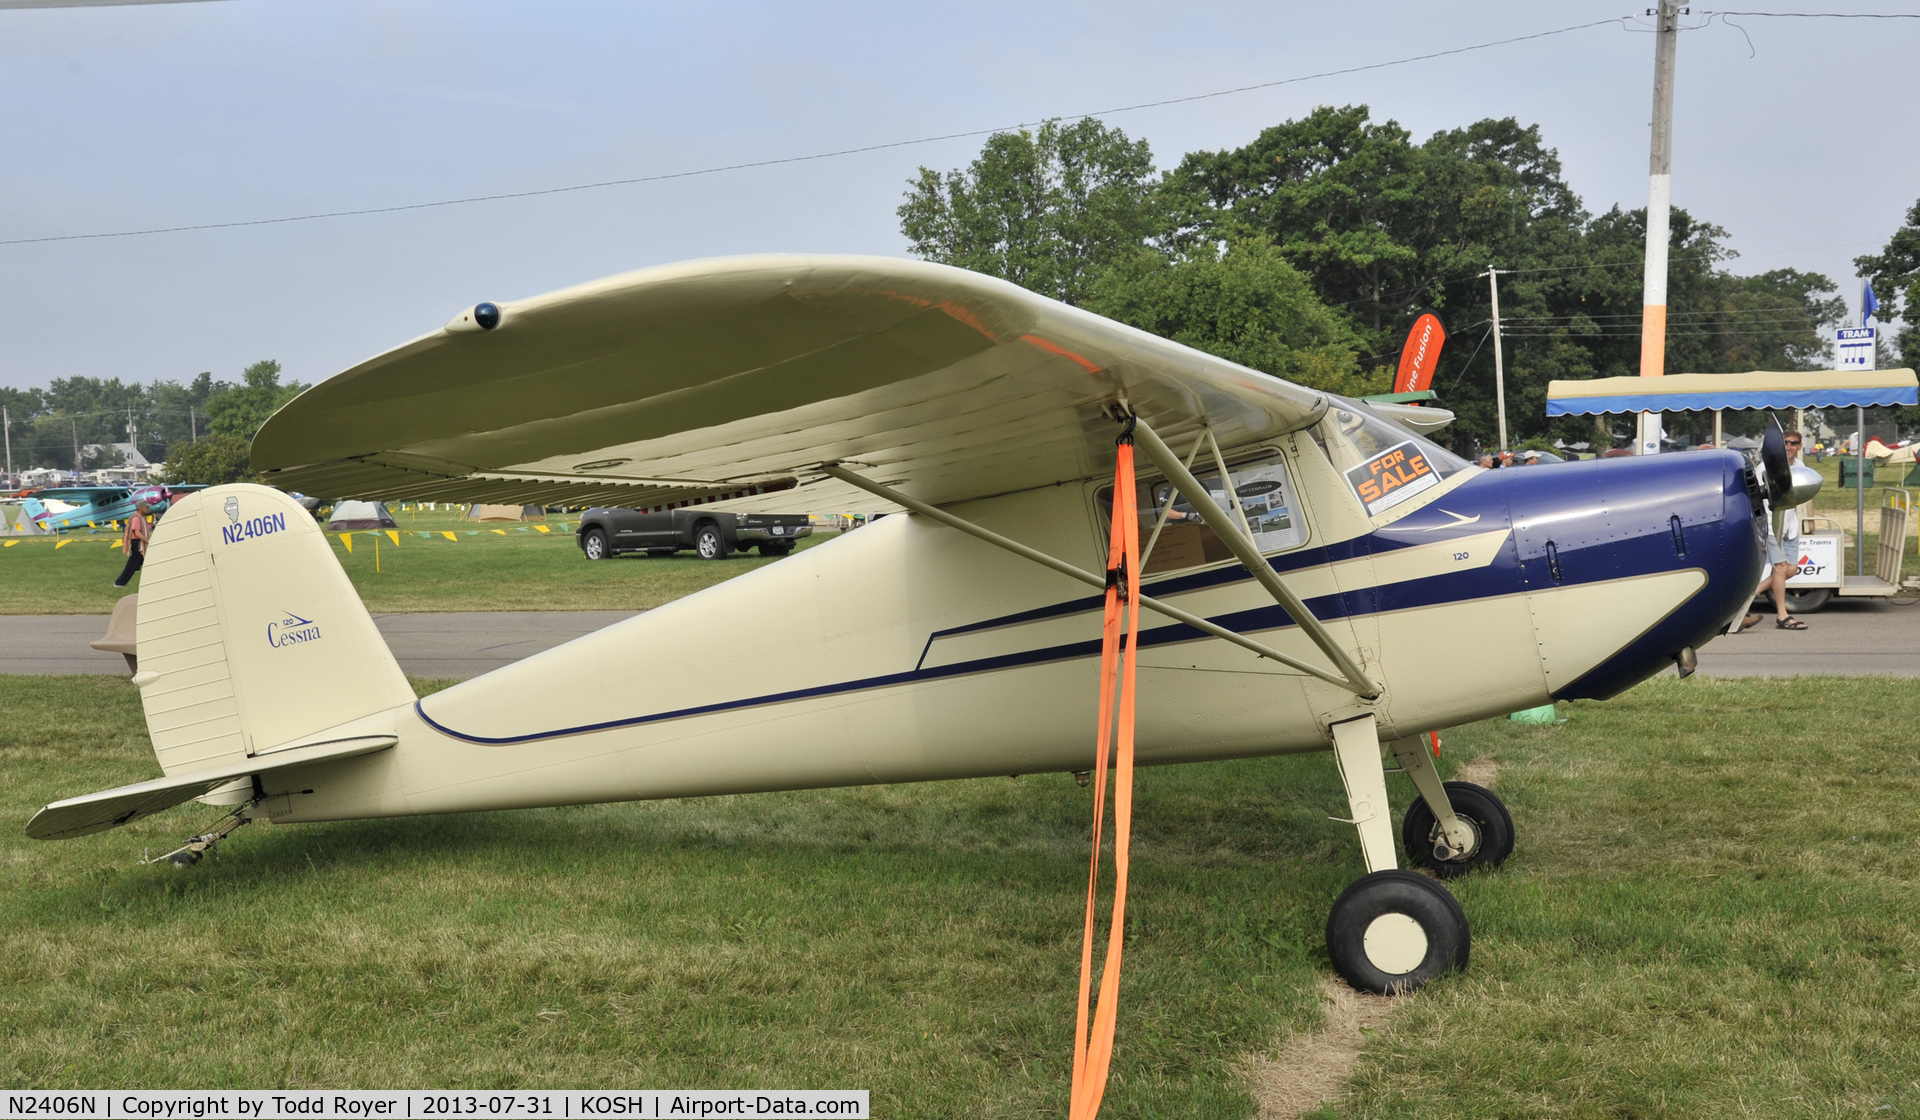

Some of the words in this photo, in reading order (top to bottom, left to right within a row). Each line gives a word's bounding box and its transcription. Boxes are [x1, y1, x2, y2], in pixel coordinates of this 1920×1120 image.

[1842, 328, 1869, 338] TRAM
[1405, 369, 1419, 393] ine
[1413, 324, 1433, 369] Fusion
[1369, 449, 1406, 475] FOR
[1357, 454, 1431, 503] SALE
[222, 512, 286, 545] N2406N
[1452, 551, 1469, 561] 120
[282, 618, 294, 626] 120
[267, 622, 322, 649] Cessna
